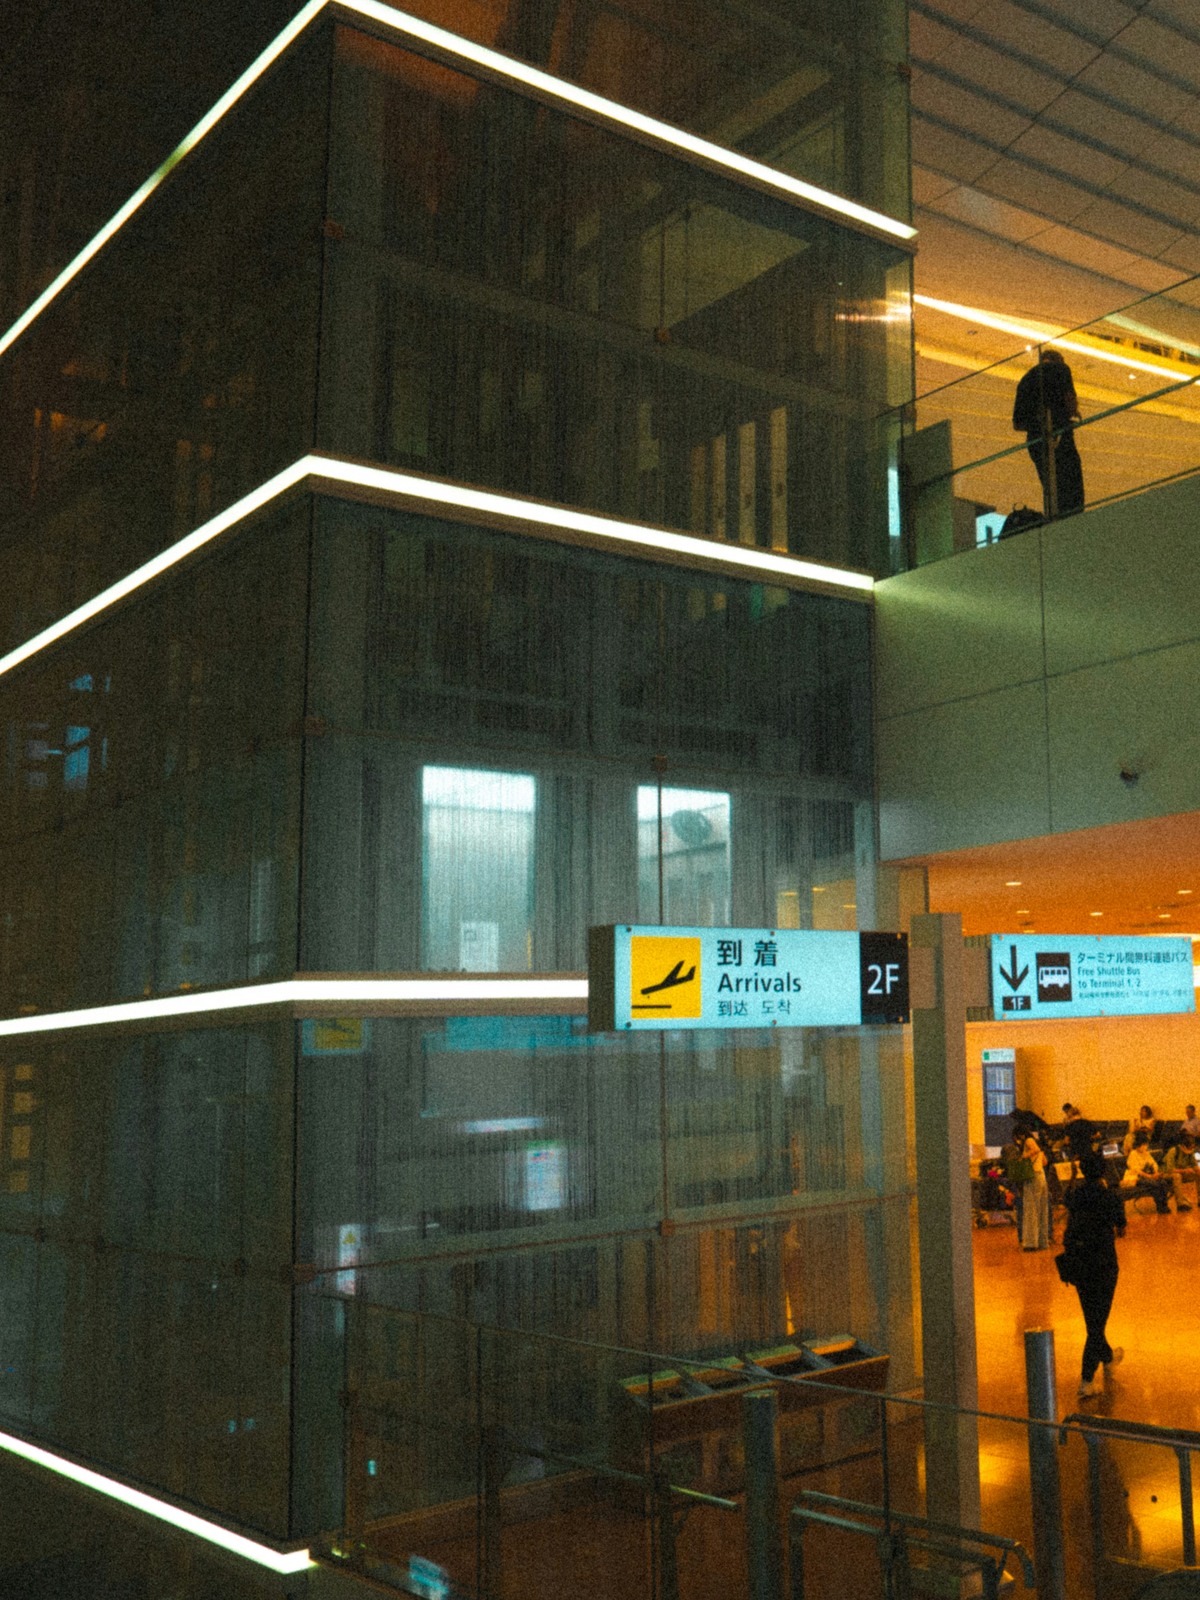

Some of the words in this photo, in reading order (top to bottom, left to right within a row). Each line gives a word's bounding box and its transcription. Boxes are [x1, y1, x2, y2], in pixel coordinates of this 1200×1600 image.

[717, 940, 778, 967] 到着
[717, 972, 802, 993] Arrivals
[867, 963, 899, 995] 2F
[1010, 997, 1024, 1010] 1F
